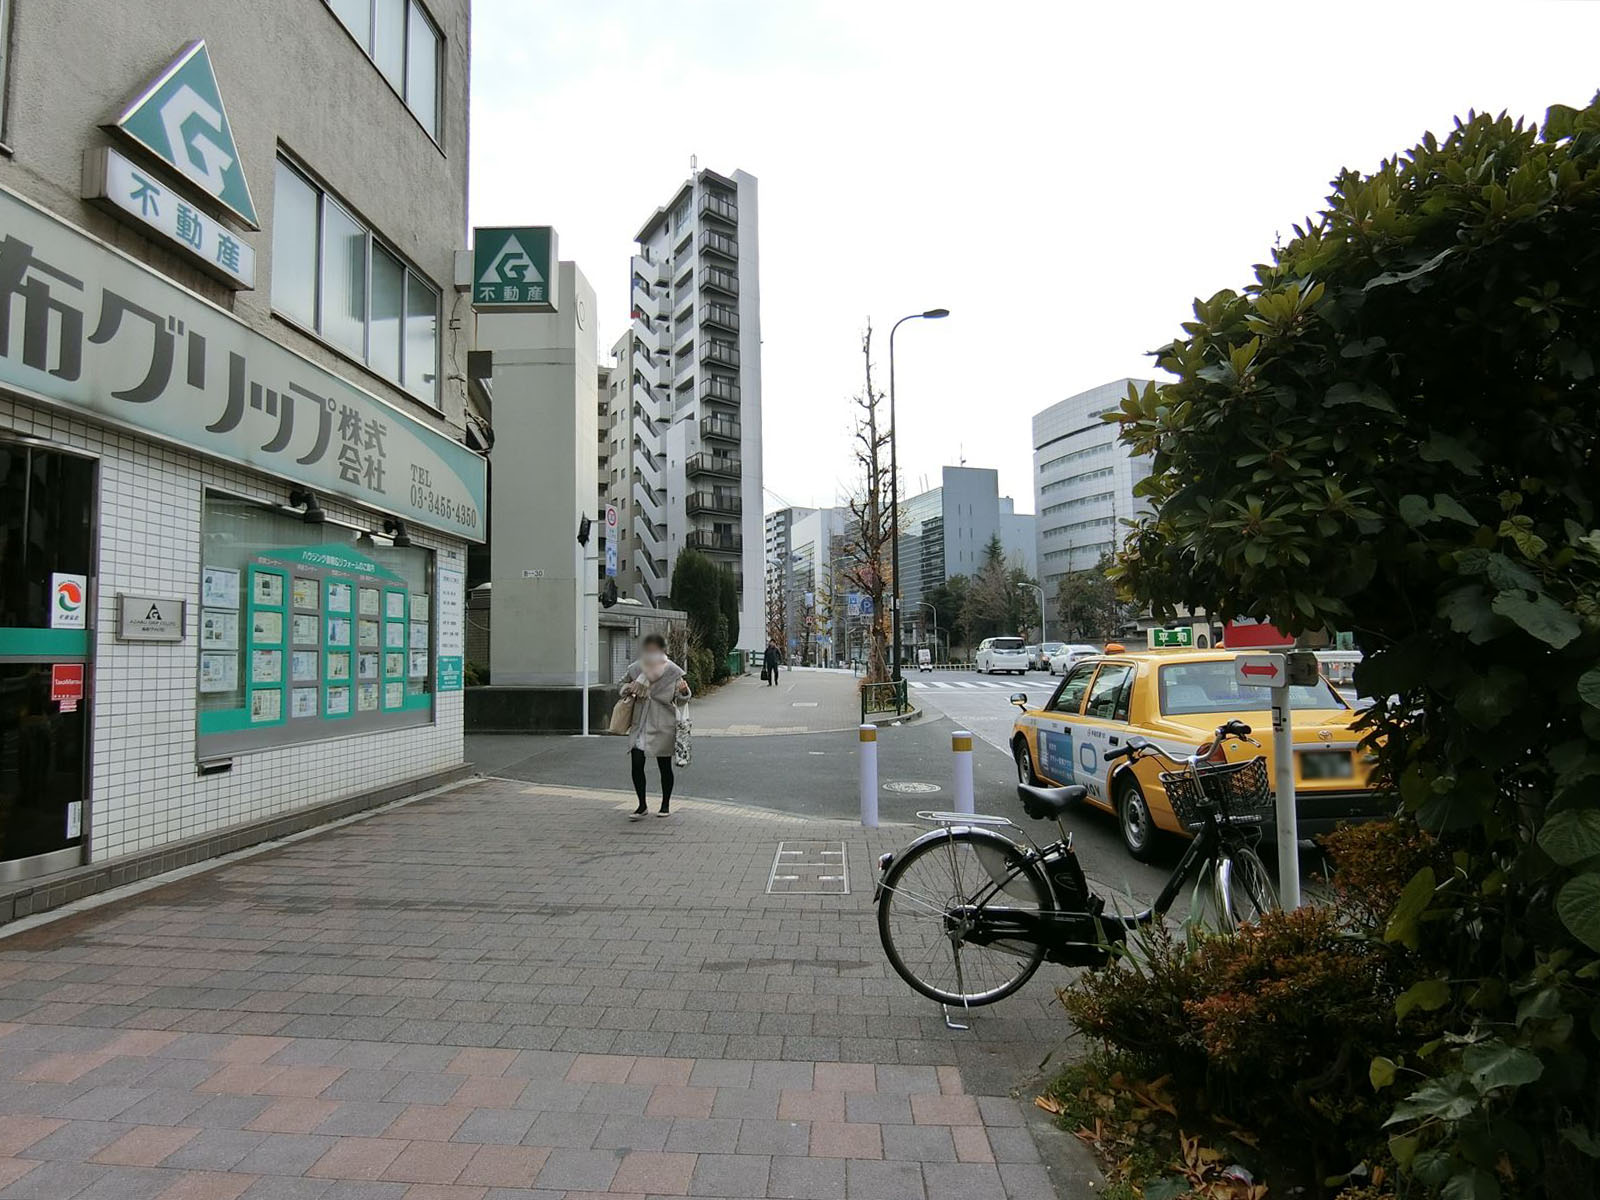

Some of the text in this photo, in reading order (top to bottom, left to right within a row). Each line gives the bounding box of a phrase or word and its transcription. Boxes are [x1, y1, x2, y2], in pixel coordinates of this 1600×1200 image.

[130, 171, 241, 274] 不動産
[480, 286, 543, 302] 不動産
[411, 463, 432, 489] TEL
[1158, 632, 1188, 643] 平和
